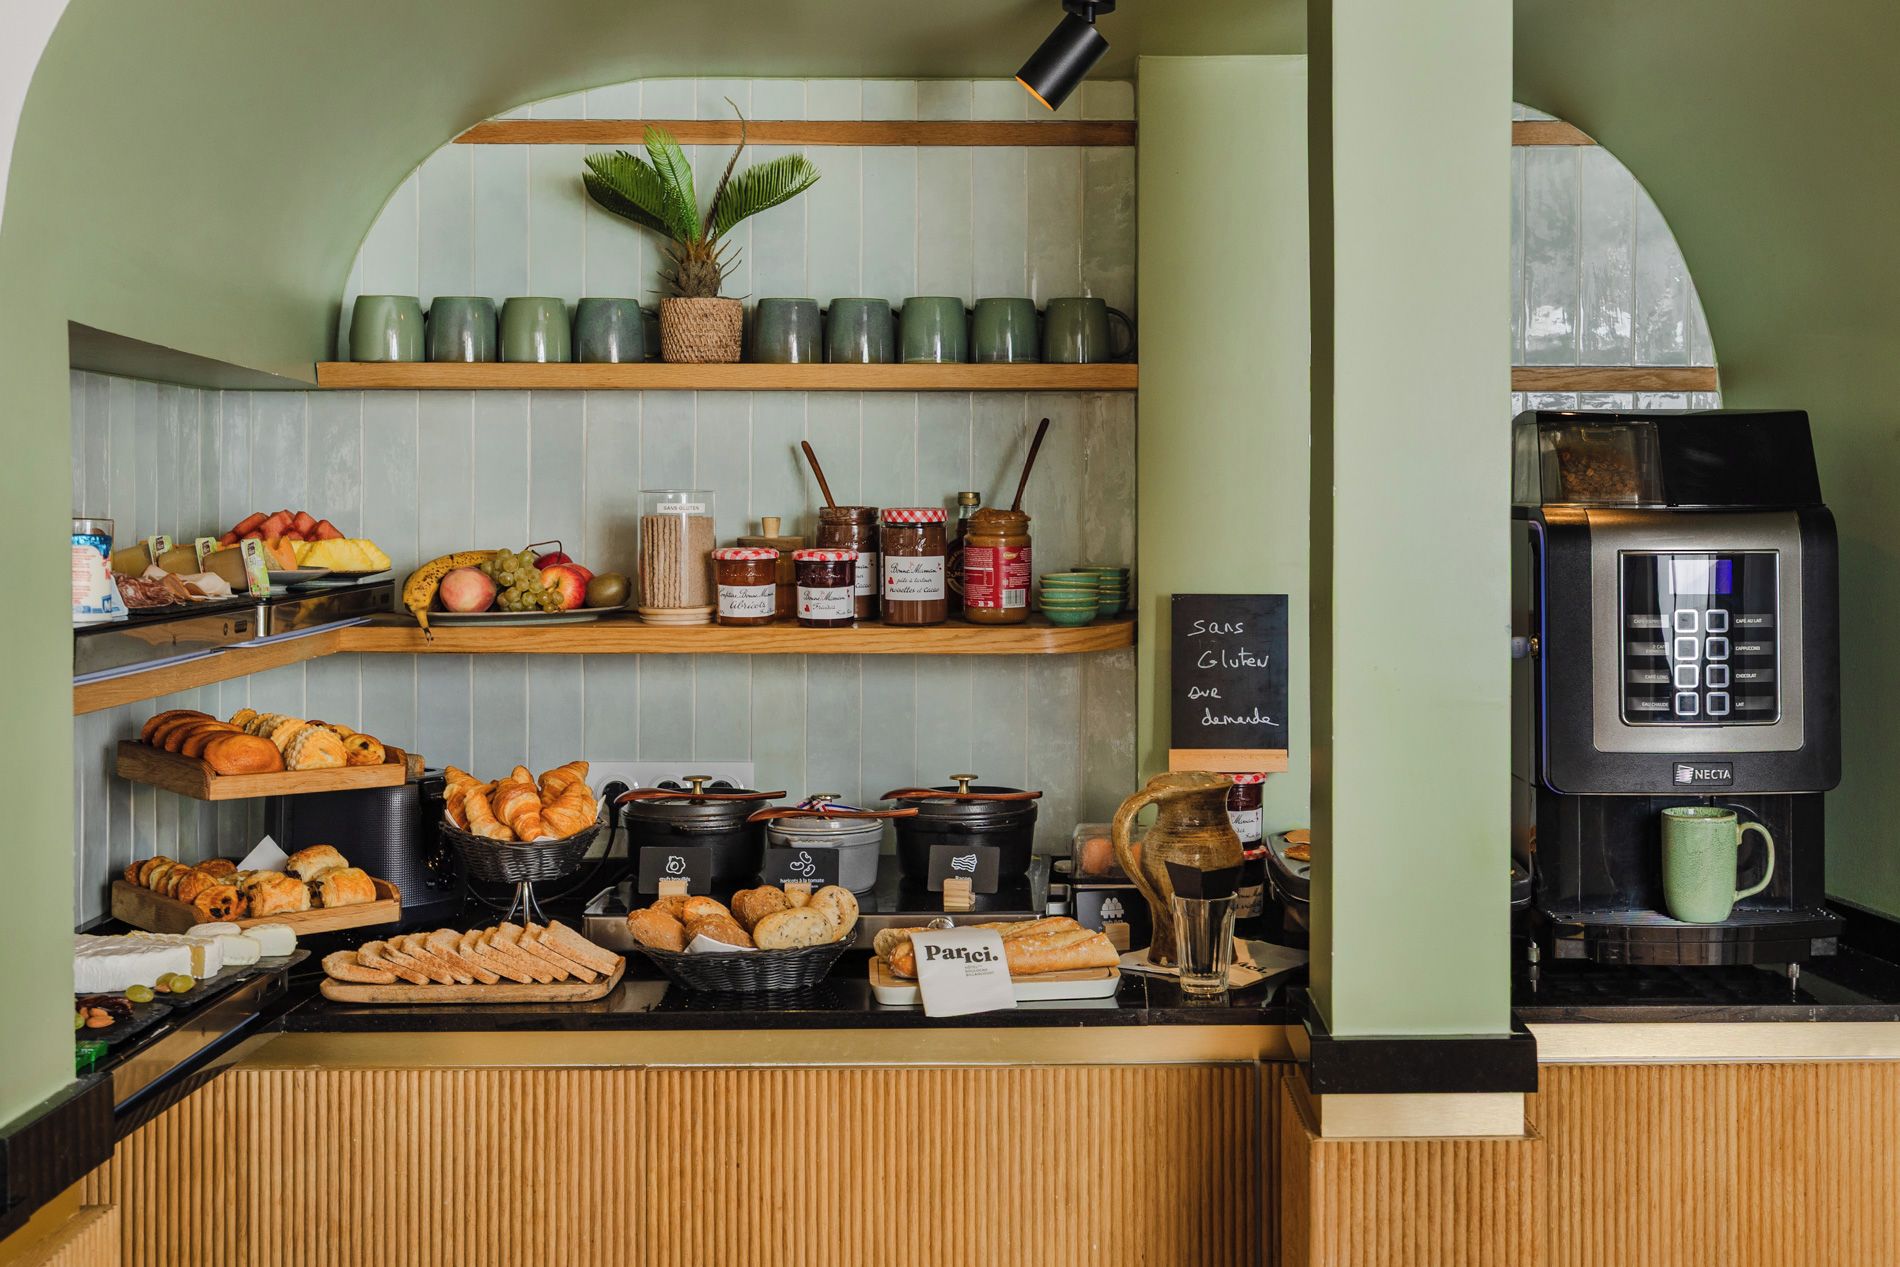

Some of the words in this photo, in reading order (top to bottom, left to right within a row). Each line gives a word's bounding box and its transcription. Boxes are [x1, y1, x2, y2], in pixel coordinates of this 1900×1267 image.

[890, 562, 910, 574] Bonne
[1201, 706, 1280, 726] demande
[1694, 769, 1732, 780] NECTA
